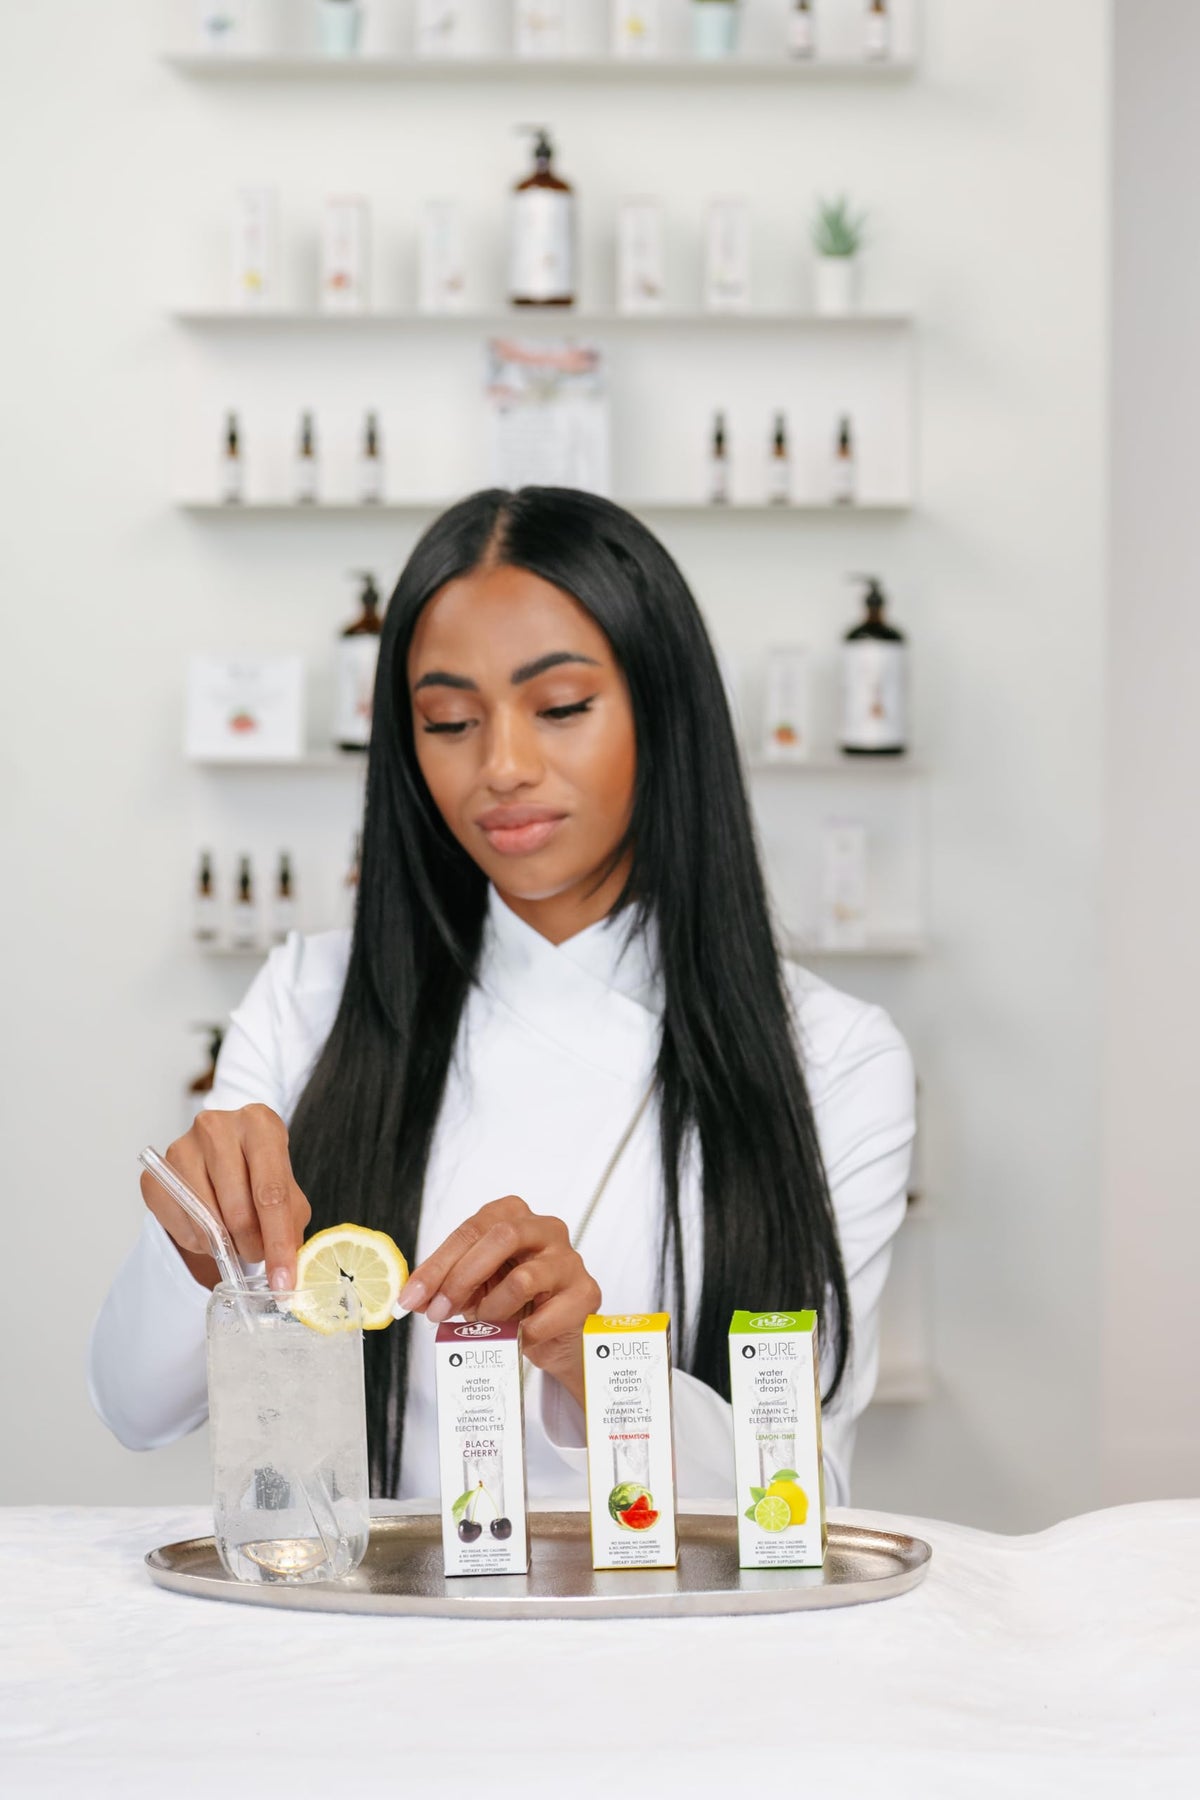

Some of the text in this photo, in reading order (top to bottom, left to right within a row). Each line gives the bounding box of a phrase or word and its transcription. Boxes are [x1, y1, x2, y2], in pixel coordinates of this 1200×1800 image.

[612, 1342, 650, 1356] PURE
[758, 1342, 796, 1356] PURE
[465, 1350, 503, 1365] PURE
[608, 1376, 642, 1384] infusion
[754, 1376, 788, 1384] infusion
[614, 1385, 638, 1393] drops
[759, 1385, 784, 1393] drops
[602, 1416, 652, 1424] ELECTROLYTES
[749, 1416, 799, 1424] ELECTROLYTES
[455, 1424, 504, 1432] ELECTROLYTES
[465, 1440, 496, 1448] BLACK
[462, 1449, 498, 1458] CHERRY
